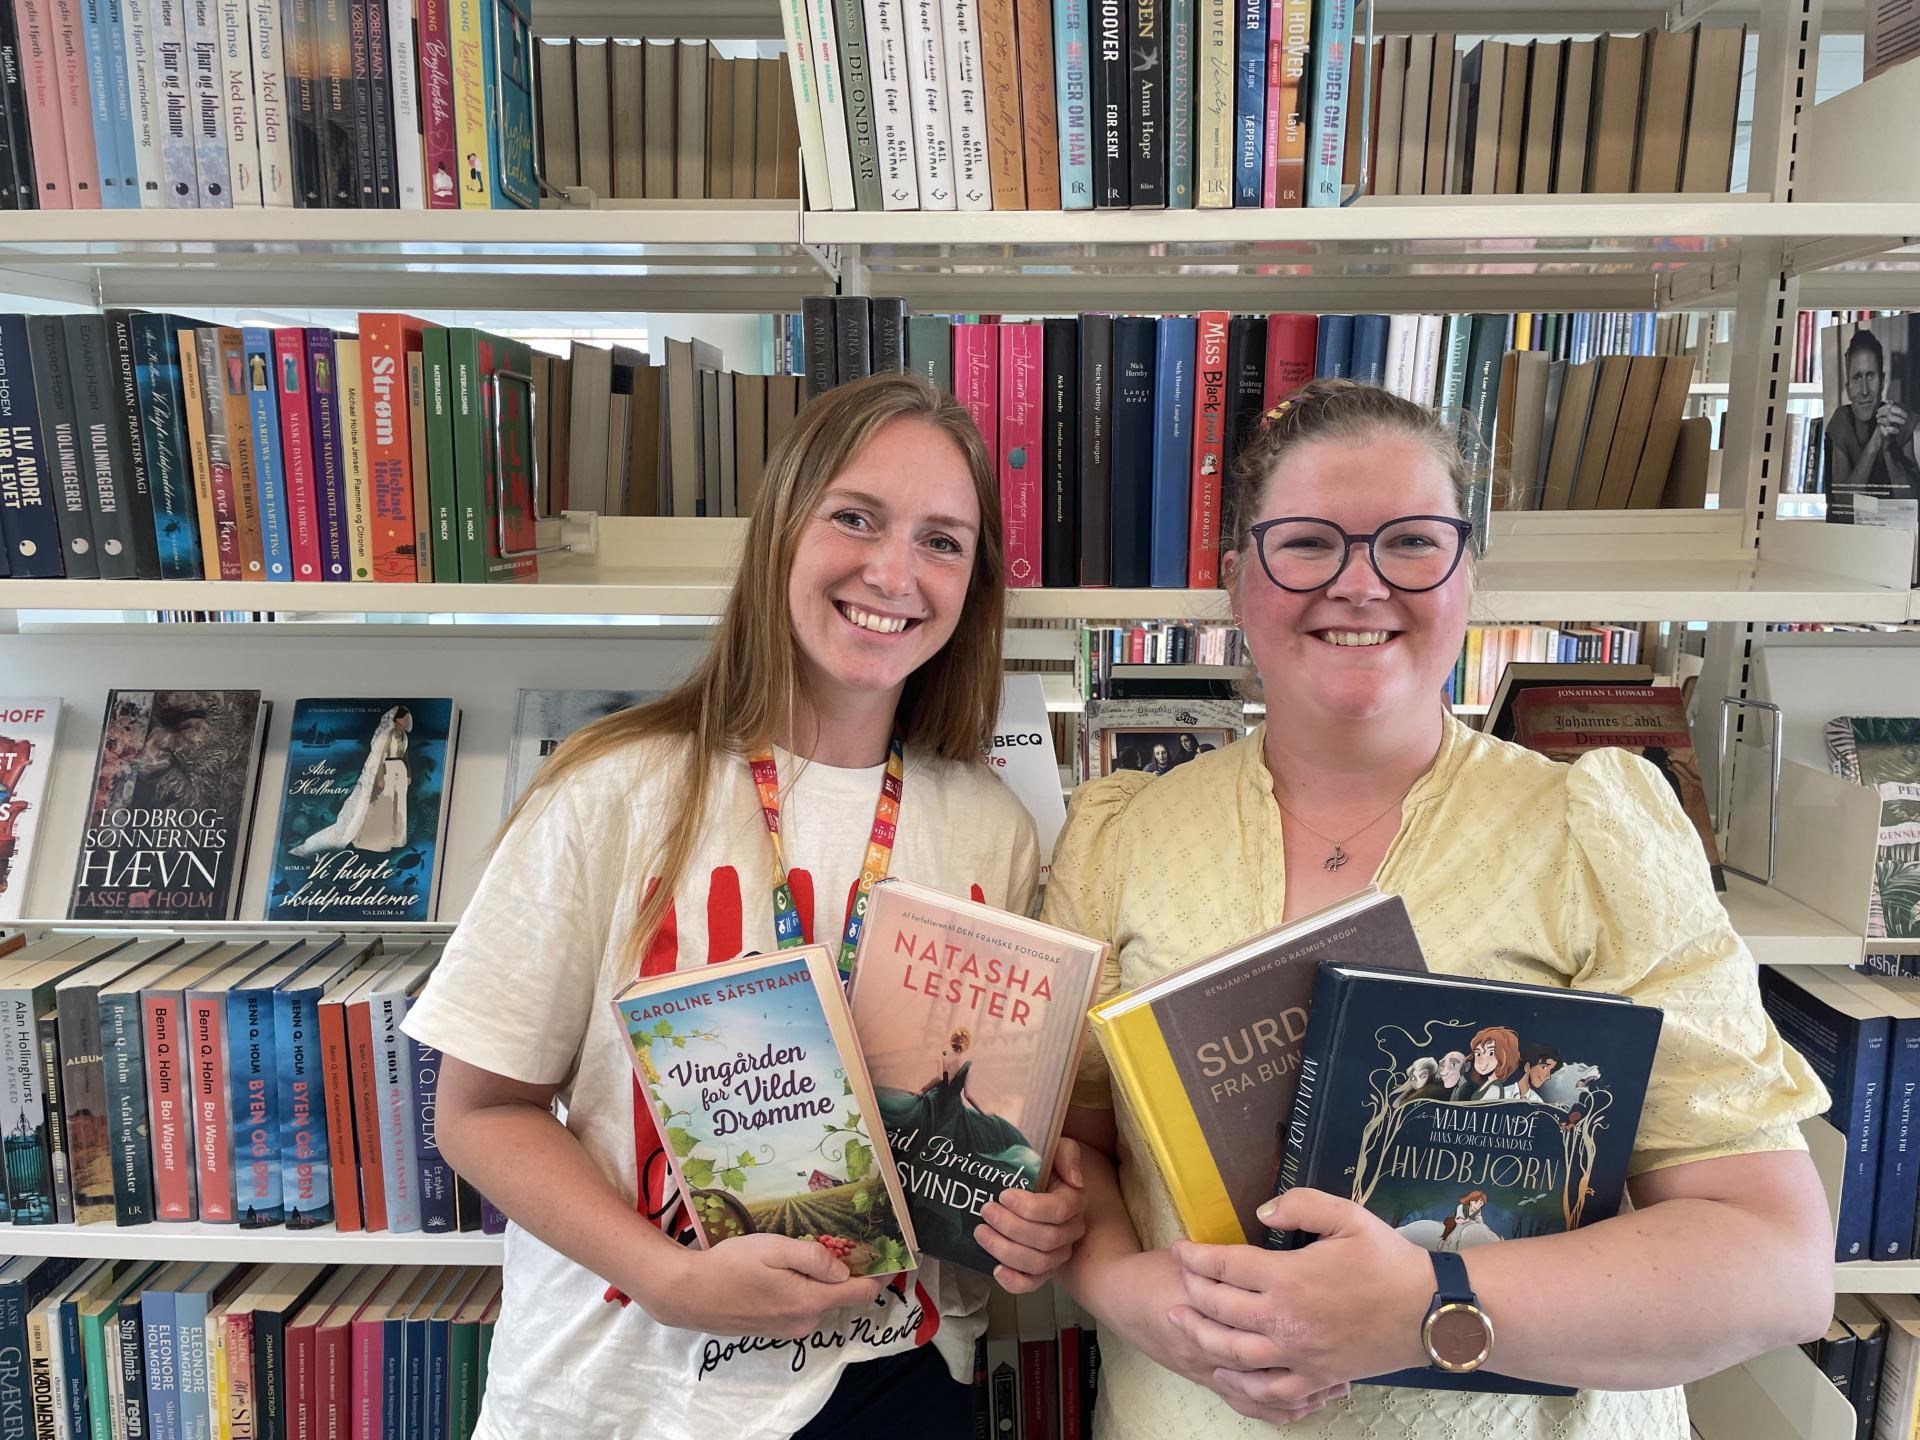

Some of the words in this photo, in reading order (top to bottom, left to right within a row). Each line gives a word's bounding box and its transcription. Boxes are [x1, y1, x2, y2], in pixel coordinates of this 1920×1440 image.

[351, 3, 365, 80] KØBENHAVN
[368, 3, 384, 81] KØBENHAVN
[1286, 11, 1306, 78] HOOVER
[162, 75, 180, 89] og
[229, 70, 243, 96] Med
[261, 71, 276, 99] Med
[849, 56, 863, 82] DE
[1142, 79, 1154, 116] Anna
[1175, 22, 1187, 167] FORVENTNING
[167, 90, 186, 138] Johanne
[200, 90, 219, 138] Johanne
[232, 103, 245, 142] tiden
[264, 105, 280, 143] tiden
[852, 90, 870, 146] ONDE
[1068, 104, 1083, 128] OM
[1106, 104, 1118, 125] FOR
[1286, 112, 1299, 144] Layla
[1323, 105, 1340, 128] OM
[886, 125, 899, 180] HONEYMAN
[898, 140, 906, 164] GAIL
[926, 124, 938, 179] HONEYMAN
[937, 140, 945, 163] GAIL
[1068, 134, 1086, 166] HAM
[1106, 127, 1119, 159] SENT
[1138, 120, 1154, 159] Hope
[1244, 114, 1255, 168] TÆPPEFALD
[859, 154, 874, 180] ÅR
[116, 321, 129, 346] ALICE
[813, 317, 824, 356] ANNA
[848, 318, 858, 356] ANNA
[883, 319, 894, 356] ANNA
[1206, 320, 1228, 365] Miss
[1450, 332, 1467, 368] Anna
[120, 348, 136, 407] HOFFMAN
[1125, 370, 1148, 378] Hornby
[1483, 360, 1491, 375] Inge
[371, 355, 396, 446] Strøm
[1056, 392, 1064, 413] Hornby
[1123, 388, 1150, 396] Langt
[12, 426, 34, 450] LIV
[128, 415, 144, 471] PRAKTISK
[17, 456, 42, 507] ANDRE
[56, 423, 84, 513] VIOLINMEGEREN
[90, 423, 117, 513] VIOLINMEGEREN
[135, 474, 147, 495] MAGI
[216, 488, 230, 517] over
[354, 478, 363, 512] Flammen
[374, 460, 392, 518] Holbek
[389, 458, 405, 522] Michael
[1204, 482, 1212, 504] NICK
[356, 513, 363, 525] og
[441, 522, 449, 541] HOLCK
[1200, 506, 1211, 551] HORNBY
[268, 537, 281, 556] TING
[357, 525, 365, 557] Citronen
[1558, 690, 1606, 698] JONATHAN
[1615, 690, 1655, 698] HOWARD
[1553, 714, 1620, 730] Johannes
[1622, 715, 1662, 728] Cabal
[1575, 732, 1666, 746] DETEKTIVEN
[994, 733, 1042, 748] BECQ
[302, 759, 336, 776] Alice
[289, 779, 350, 796] Hoffman
[99, 808, 224, 828] LODBROG-
[85, 829, 227, 848] SØNNERNES
[77, 850, 223, 888] HÆVN
[332, 854, 396, 891] fulgte
[74, 891, 126, 908] LASSE
[156, 892, 214, 908] HOLM
[279, 881, 420, 912] skildpadderne
[911, 913, 948, 929] forfatteren
[956, 927, 975, 937] DEN
[975, 933, 1014, 951] FRANSKE
[1015, 945, 1061, 964] FOTOGRAF
[894, 930, 1052, 1002] NATASHA
[1205, 973, 1251, 997] BENJAMIN
[1252, 963, 1273, 977] BIRK
[1275, 957, 1288, 967] OG
[1289, 940, 1326, 962] RASMUS
[1327, 927, 1358, 945] KROGH
[630, 993, 713, 1023] CAROLINE
[716, 969, 812, 1003] SÄFSTRAND
[903, 964, 1032, 1027] LESTER
[15, 1001, 27, 1028] Alan
[114, 1006, 124, 1036] Benn
[155, 1007, 168, 1041] Benn
[199, 1009, 210, 1042] Benn
[383, 1000, 393, 1031] BENN
[1197, 1007, 1309, 1077] SURD
[18, 1031, 34, 1103] Hollinghurst
[118, 1053, 128, 1084] Holm
[159, 1060, 171, 1094] Holm
[202, 1061, 213, 1095] Holm
[387, 1049, 399, 1084] HOLM
[667, 1043, 807, 1088] Vingården
[1210, 1073, 1255, 1103] FRA
[1258, 1049, 1303, 1083] BUN
[1296, 1056, 1319, 1097] MAJA
[249, 1079, 266, 1124] BYEN
[293, 1082, 310, 1127] BYEN
[701, 1087, 730, 1111] for
[734, 1069, 816, 1105] Vilde
[1866, 1083, 1877, 1097] DE
[1903, 1083, 1915, 1097] DE
[161, 1101, 173, 1122] Boi
[204, 1102, 215, 1123] Boi
[420, 1093, 437, 1150] HOLM
[711, 1096, 836, 1137] Drømme
[1287, 1098, 1312, 1153] LUNDE
[1431, 1107, 1478, 1133] MAJA
[1481, 1112, 1539, 1139] LUNDE
[1864, 1098, 1873, 1125] SATTE
[162, 1123, 175, 1172] Wagner
[204, 1123, 218, 1173] Wagner
[1429, 1131, 1452, 1144] HANS
[1454, 1133, 1493, 1149] JØRGEN
[1493, 1135, 1534, 1151] SANDNES
[124, 1144, 137, 1193] blomster
[423, 1169, 431, 1179] af
[434, 1165, 443, 1174] Et
[919, 1135, 1030, 1191] Bricards
[1391, 1144, 1559, 1192] HVIDBJØRN
[424, 1181, 432, 1198] tiden
[434, 1175, 443, 1200] stykke
[6, 1298, 19, 1327] LASSE
[120, 1319, 136, 1340] Stig
[849, 1305, 924, 1347] Niente
[122, 1343, 141, 1381] Holmås
[147, 1324, 161, 1391] HOLMGREN
[158, 1324, 174, 1391] ELEONORE
[179, 1326, 192, 1393] HOLMGREN
[191, 1326, 205, 1393] ELEONORE
[266, 1334, 274, 1369] JOHANNA
[0, 1346, 23, 1440] GRÆKER
[267, 1370, 276, 1417] HOLMSTRÖM
[1088, 1368, 1096, 1389] Hugo
[126, 1399, 142, 1438] regn
